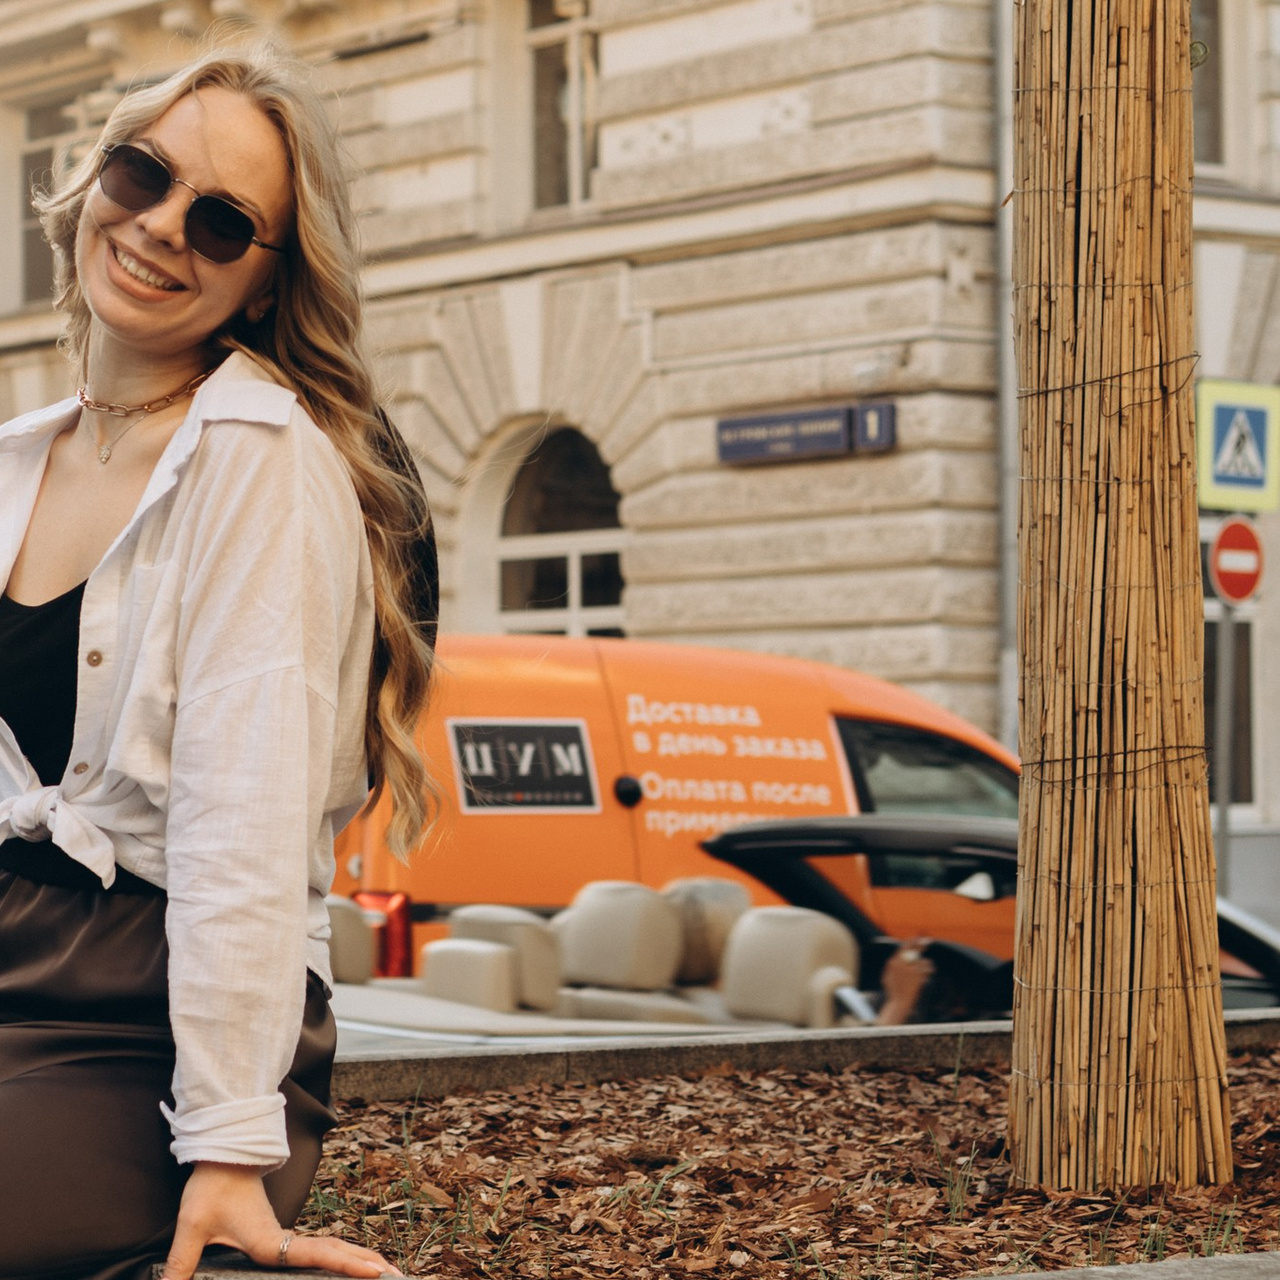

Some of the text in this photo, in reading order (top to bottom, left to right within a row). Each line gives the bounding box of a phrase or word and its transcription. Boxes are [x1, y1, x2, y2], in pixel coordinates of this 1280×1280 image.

[627, 693, 762, 726] Доставка
[658, 732, 727, 757] день
[732, 735, 827, 760] заказа
[640, 770, 832, 806] Оплата после
